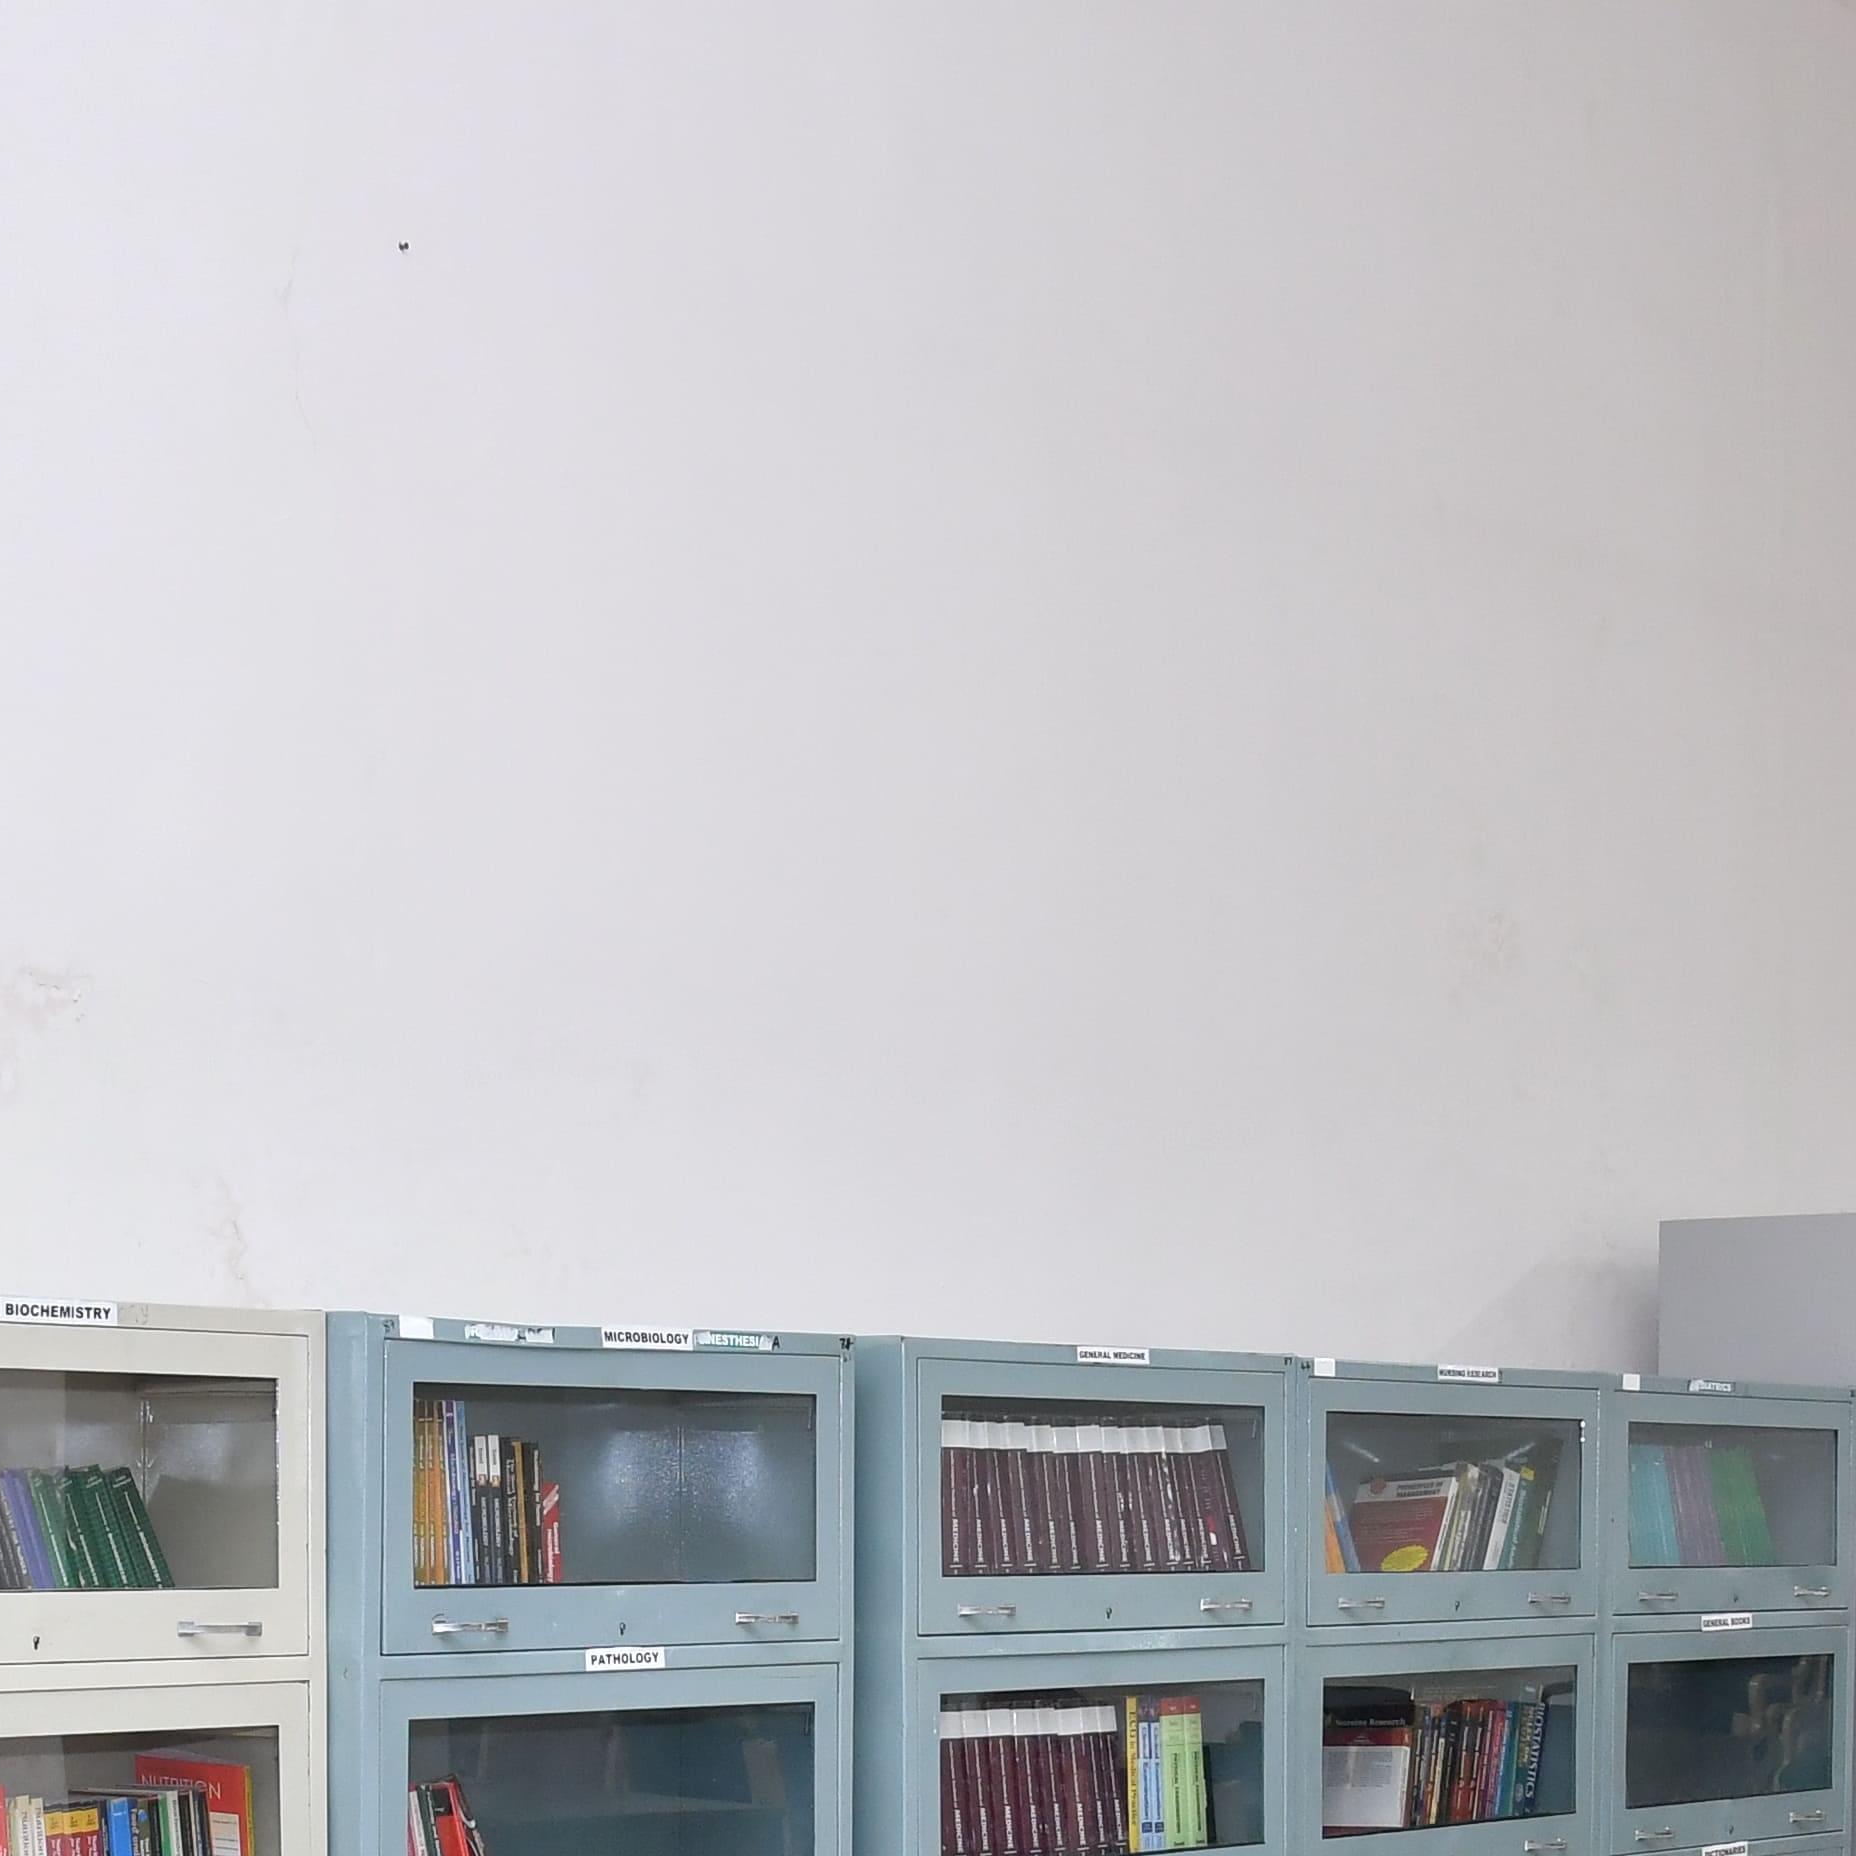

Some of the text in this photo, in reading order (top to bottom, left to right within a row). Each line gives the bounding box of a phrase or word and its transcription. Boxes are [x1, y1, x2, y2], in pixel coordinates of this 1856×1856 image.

[5, 1303, 111, 1320] BIOCHEMISTRY
[604, 1330, 689, 1345] MICROBIOLOGY
[1079, 1350, 1146, 1360] GENERAL MEDICINE
[591, 1652, 659, 1666] PATHOLOGY
[1368, 1718, 1406, 1727] Research
[129, 1808, 138, 1831] Food
[1005, 1807, 1014, 1848] MEDICINE
[1077, 1804, 1086, 1845] MEDICINE
[1115, 1800, 1123, 1840] MEDICINE
[955, 1810, 963, 1853] MEDICINE
[131, 1836, 140, 1855] and
